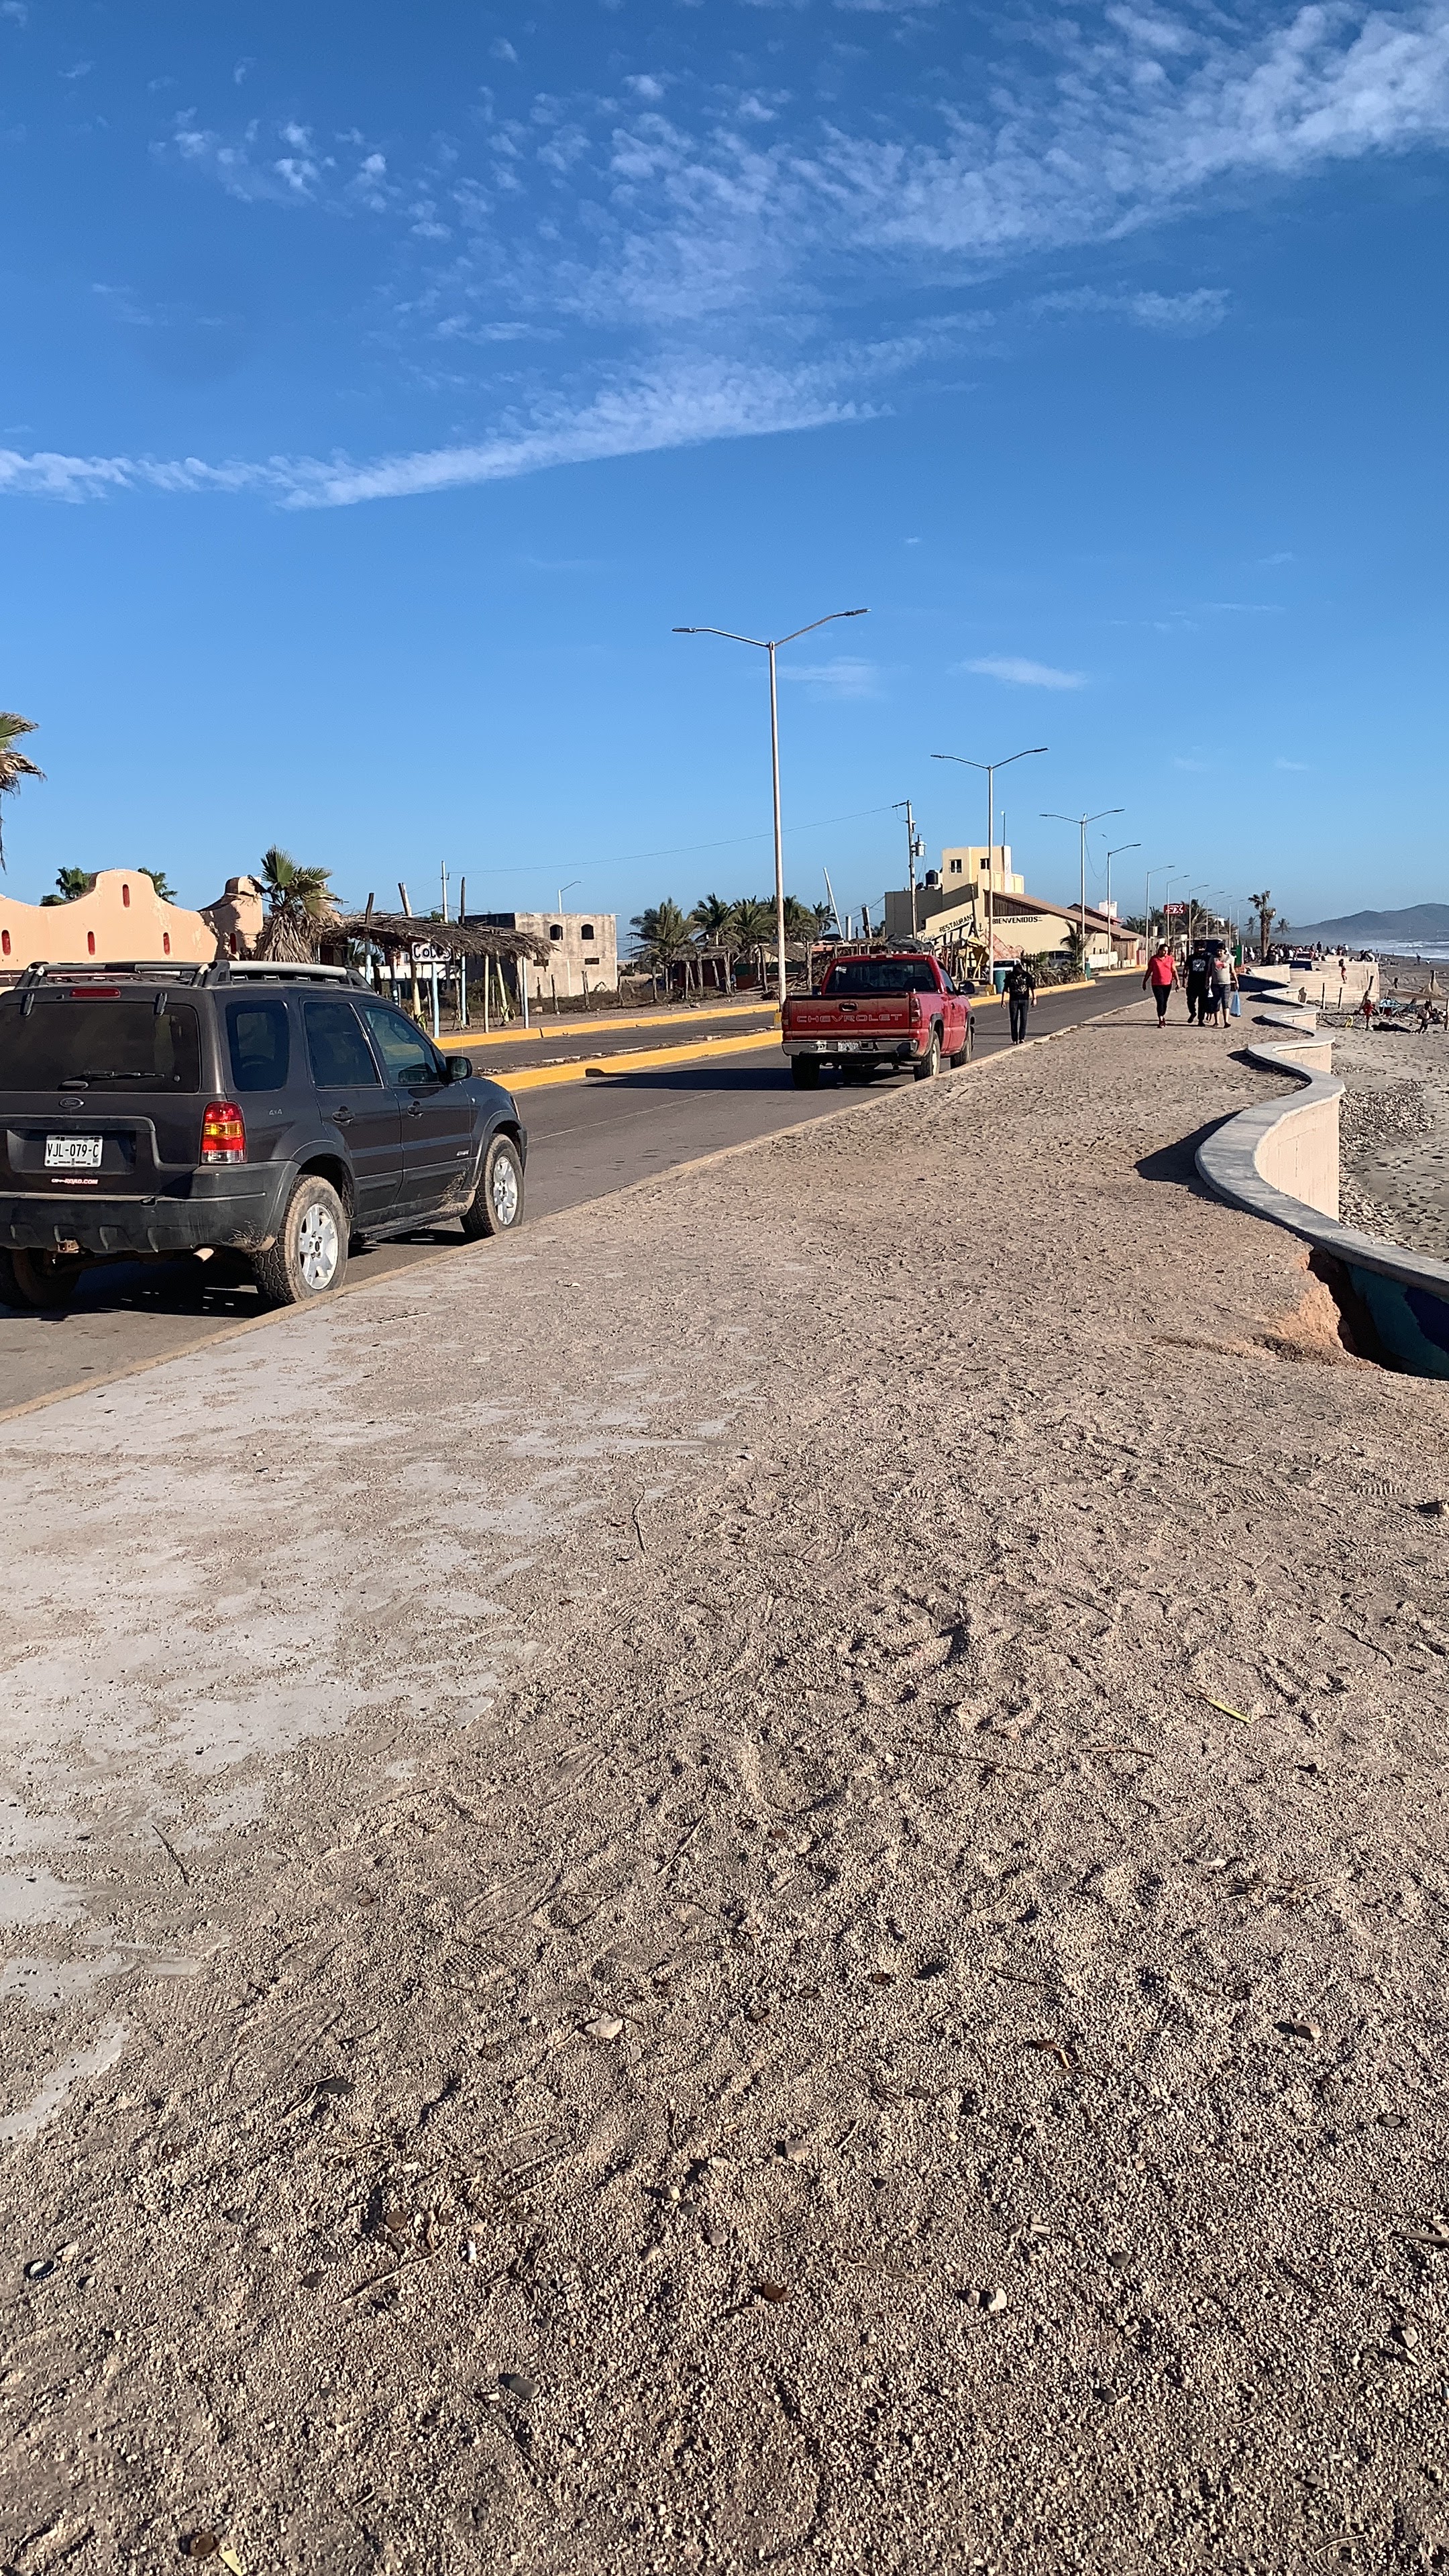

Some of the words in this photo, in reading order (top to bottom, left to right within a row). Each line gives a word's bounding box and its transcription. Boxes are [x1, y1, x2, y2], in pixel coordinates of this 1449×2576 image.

[992, 916, 1038, 924] BIENVENIDOS
[797, 1014, 902, 1023] CHEVROLET
[48, 1143, 99, 1158] VJL-079-C
